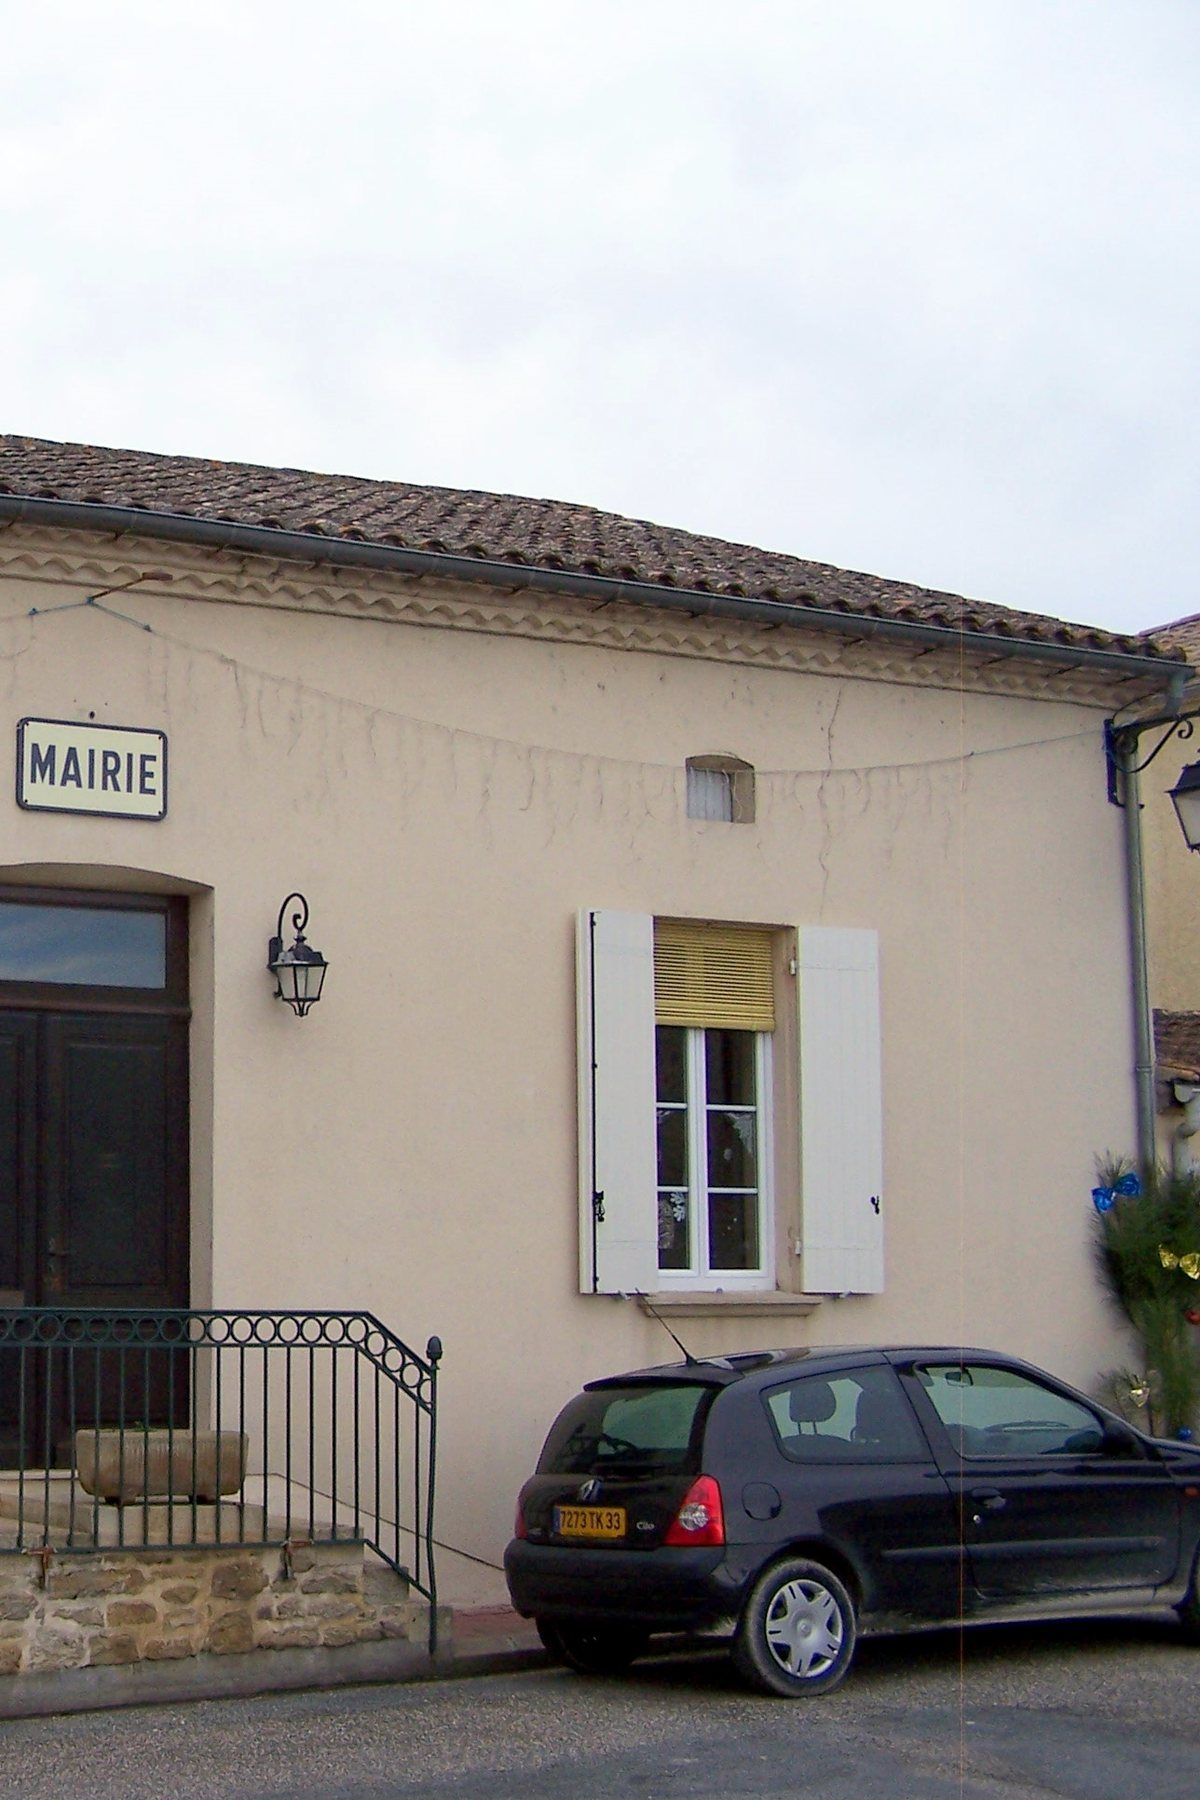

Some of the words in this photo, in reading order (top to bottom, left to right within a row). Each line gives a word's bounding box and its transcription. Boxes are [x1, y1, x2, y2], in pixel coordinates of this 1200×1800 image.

[30, 742, 157, 796] MAIRIE
[560, 1510, 587, 1528] 7273
[589, 1511, 603, 1530] TK
[606, 1512, 621, 1530] 33
[636, 1521, 655, 1530] Clio
